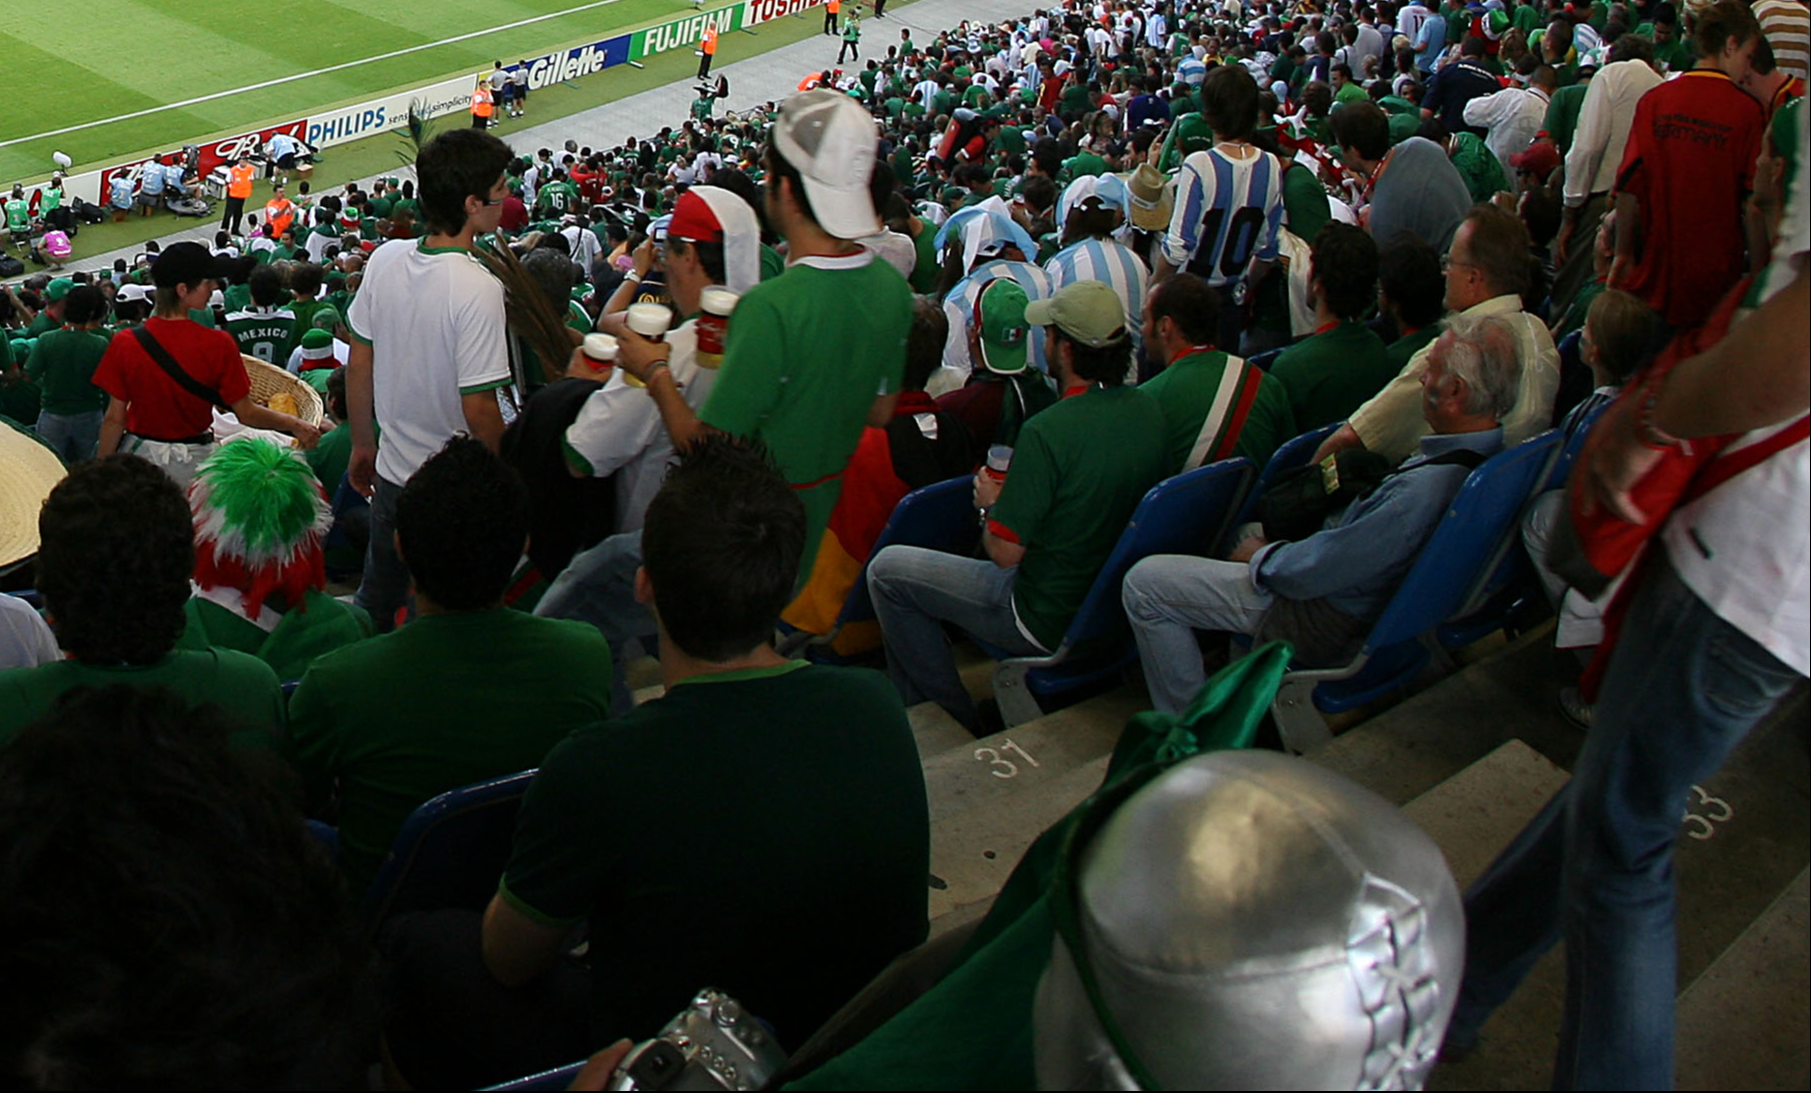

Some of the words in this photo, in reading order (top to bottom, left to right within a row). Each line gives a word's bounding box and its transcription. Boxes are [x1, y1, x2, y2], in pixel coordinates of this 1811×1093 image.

[527, 45, 608, 92] Gillette
[432, 95, 474, 114] simplicity
[308, 105, 386, 146] PHILIPS
[387, 111, 410, 126] sens
[550, 192, 564, 210] 16
[1187, 206, 1264, 279] 10
[237, 327, 289, 343] MEXICO
[973, 738, 1039, 779] 31
